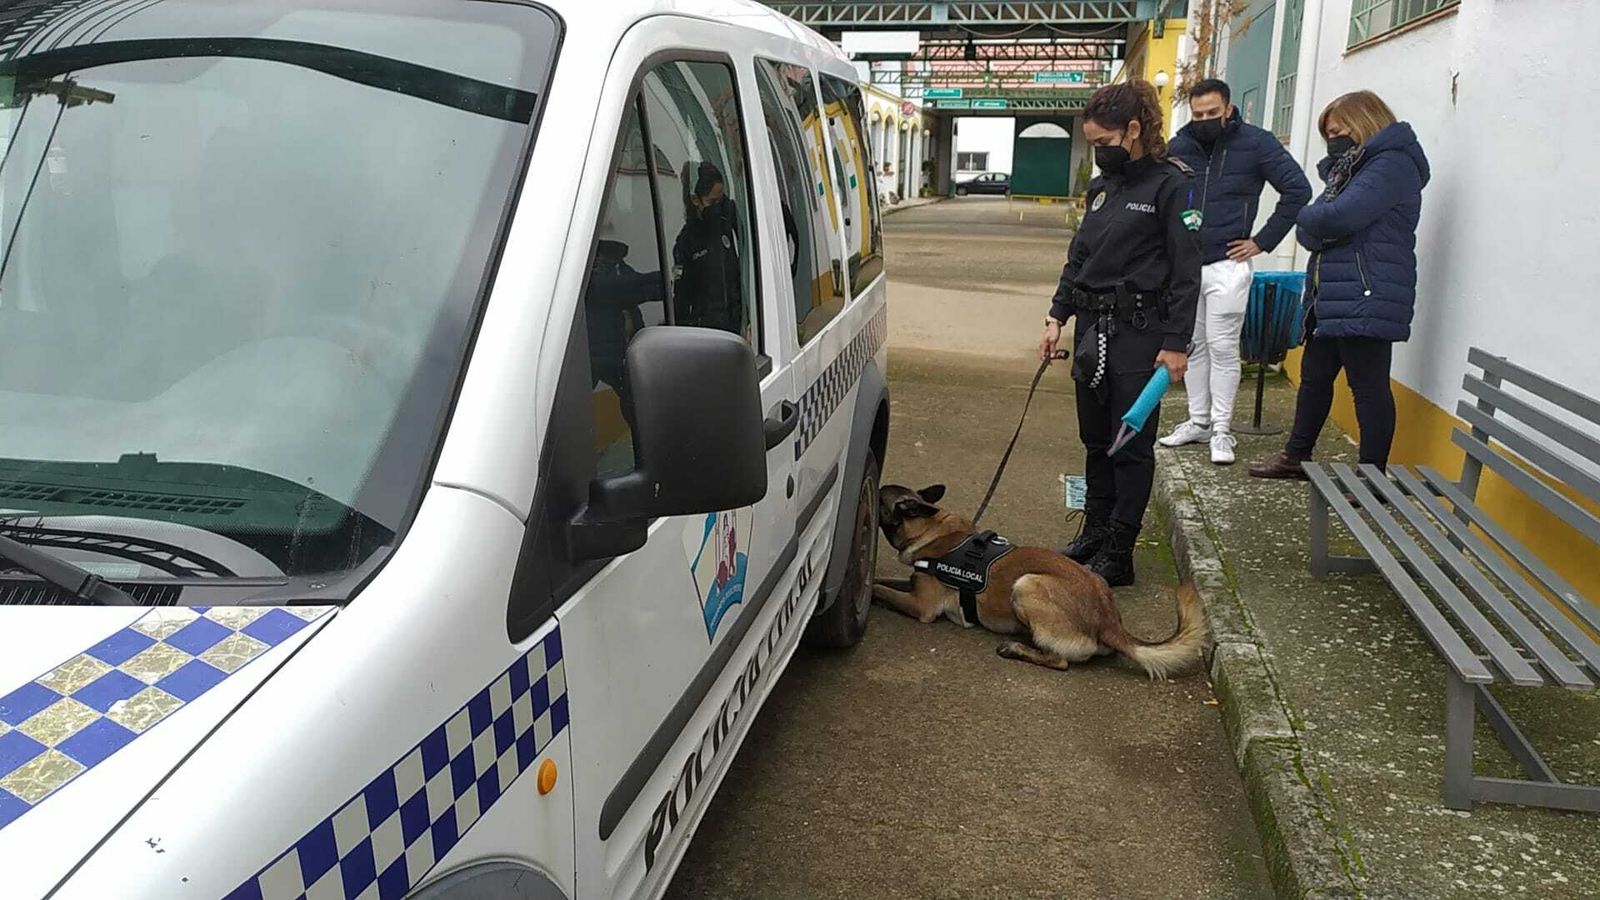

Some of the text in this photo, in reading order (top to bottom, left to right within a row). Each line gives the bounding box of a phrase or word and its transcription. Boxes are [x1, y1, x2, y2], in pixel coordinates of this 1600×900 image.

[1125, 201, 1157, 214] POLICIA
[936, 562, 983, 582] POLICIA LOCAL
